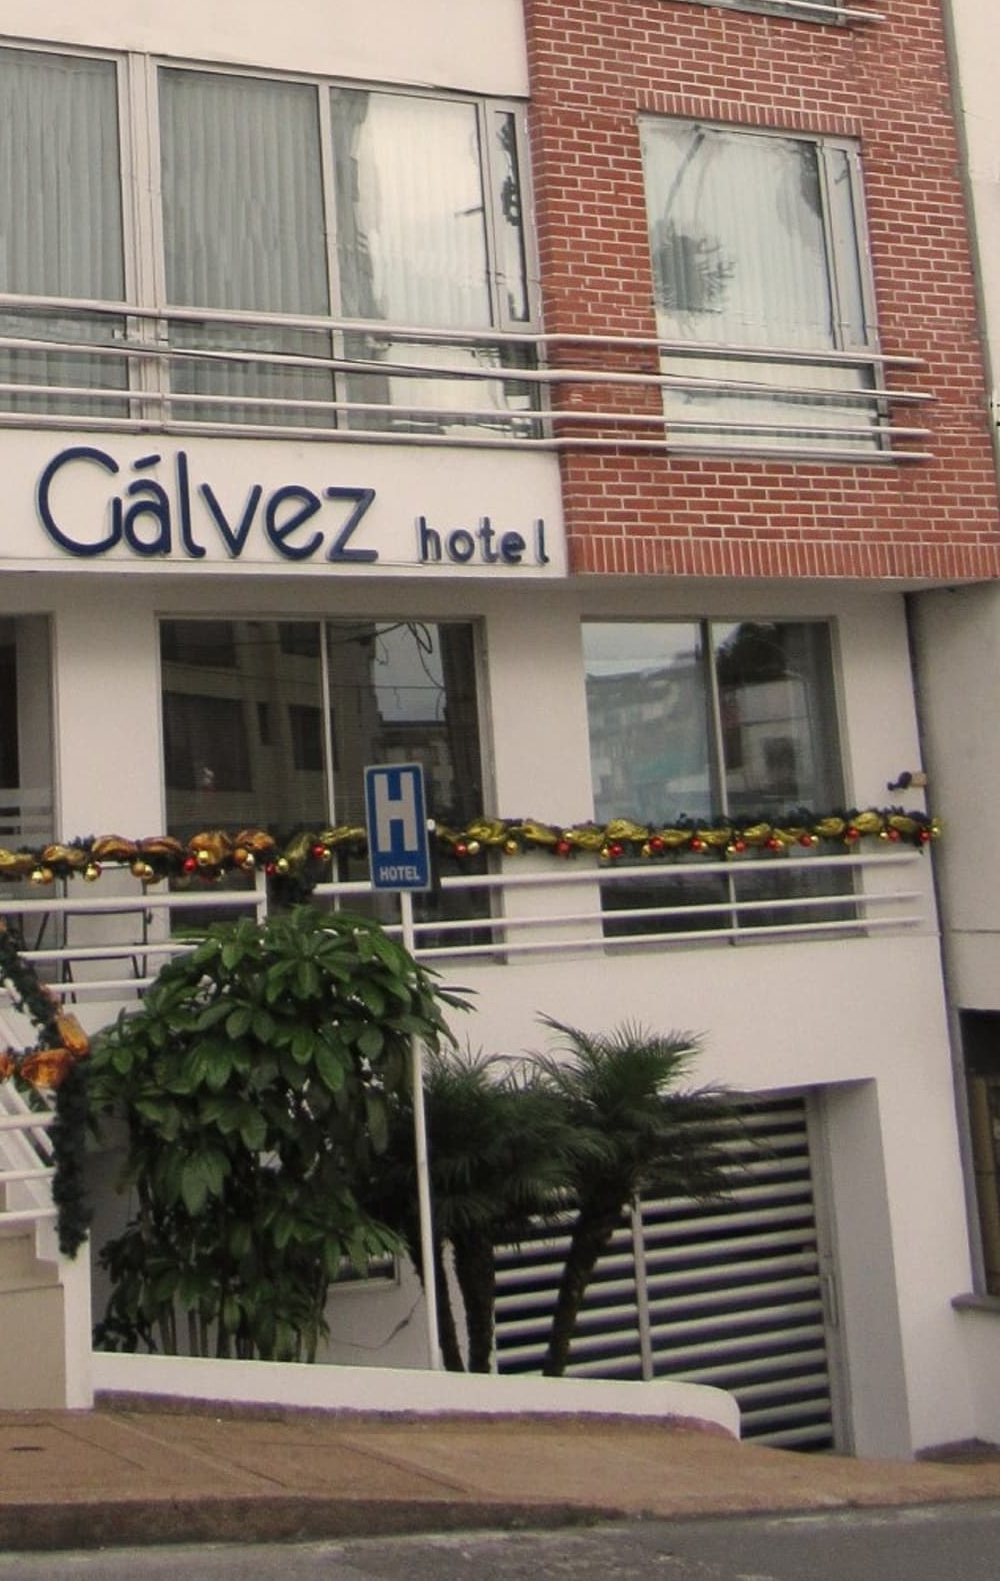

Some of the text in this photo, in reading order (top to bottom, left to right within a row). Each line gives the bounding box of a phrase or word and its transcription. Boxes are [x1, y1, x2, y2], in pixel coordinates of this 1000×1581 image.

[37, 447, 376, 562] Gálvez
[419, 517, 550, 565] hotel
[374, 773, 419, 852] H
[380, 867, 420, 882] HOTEL
